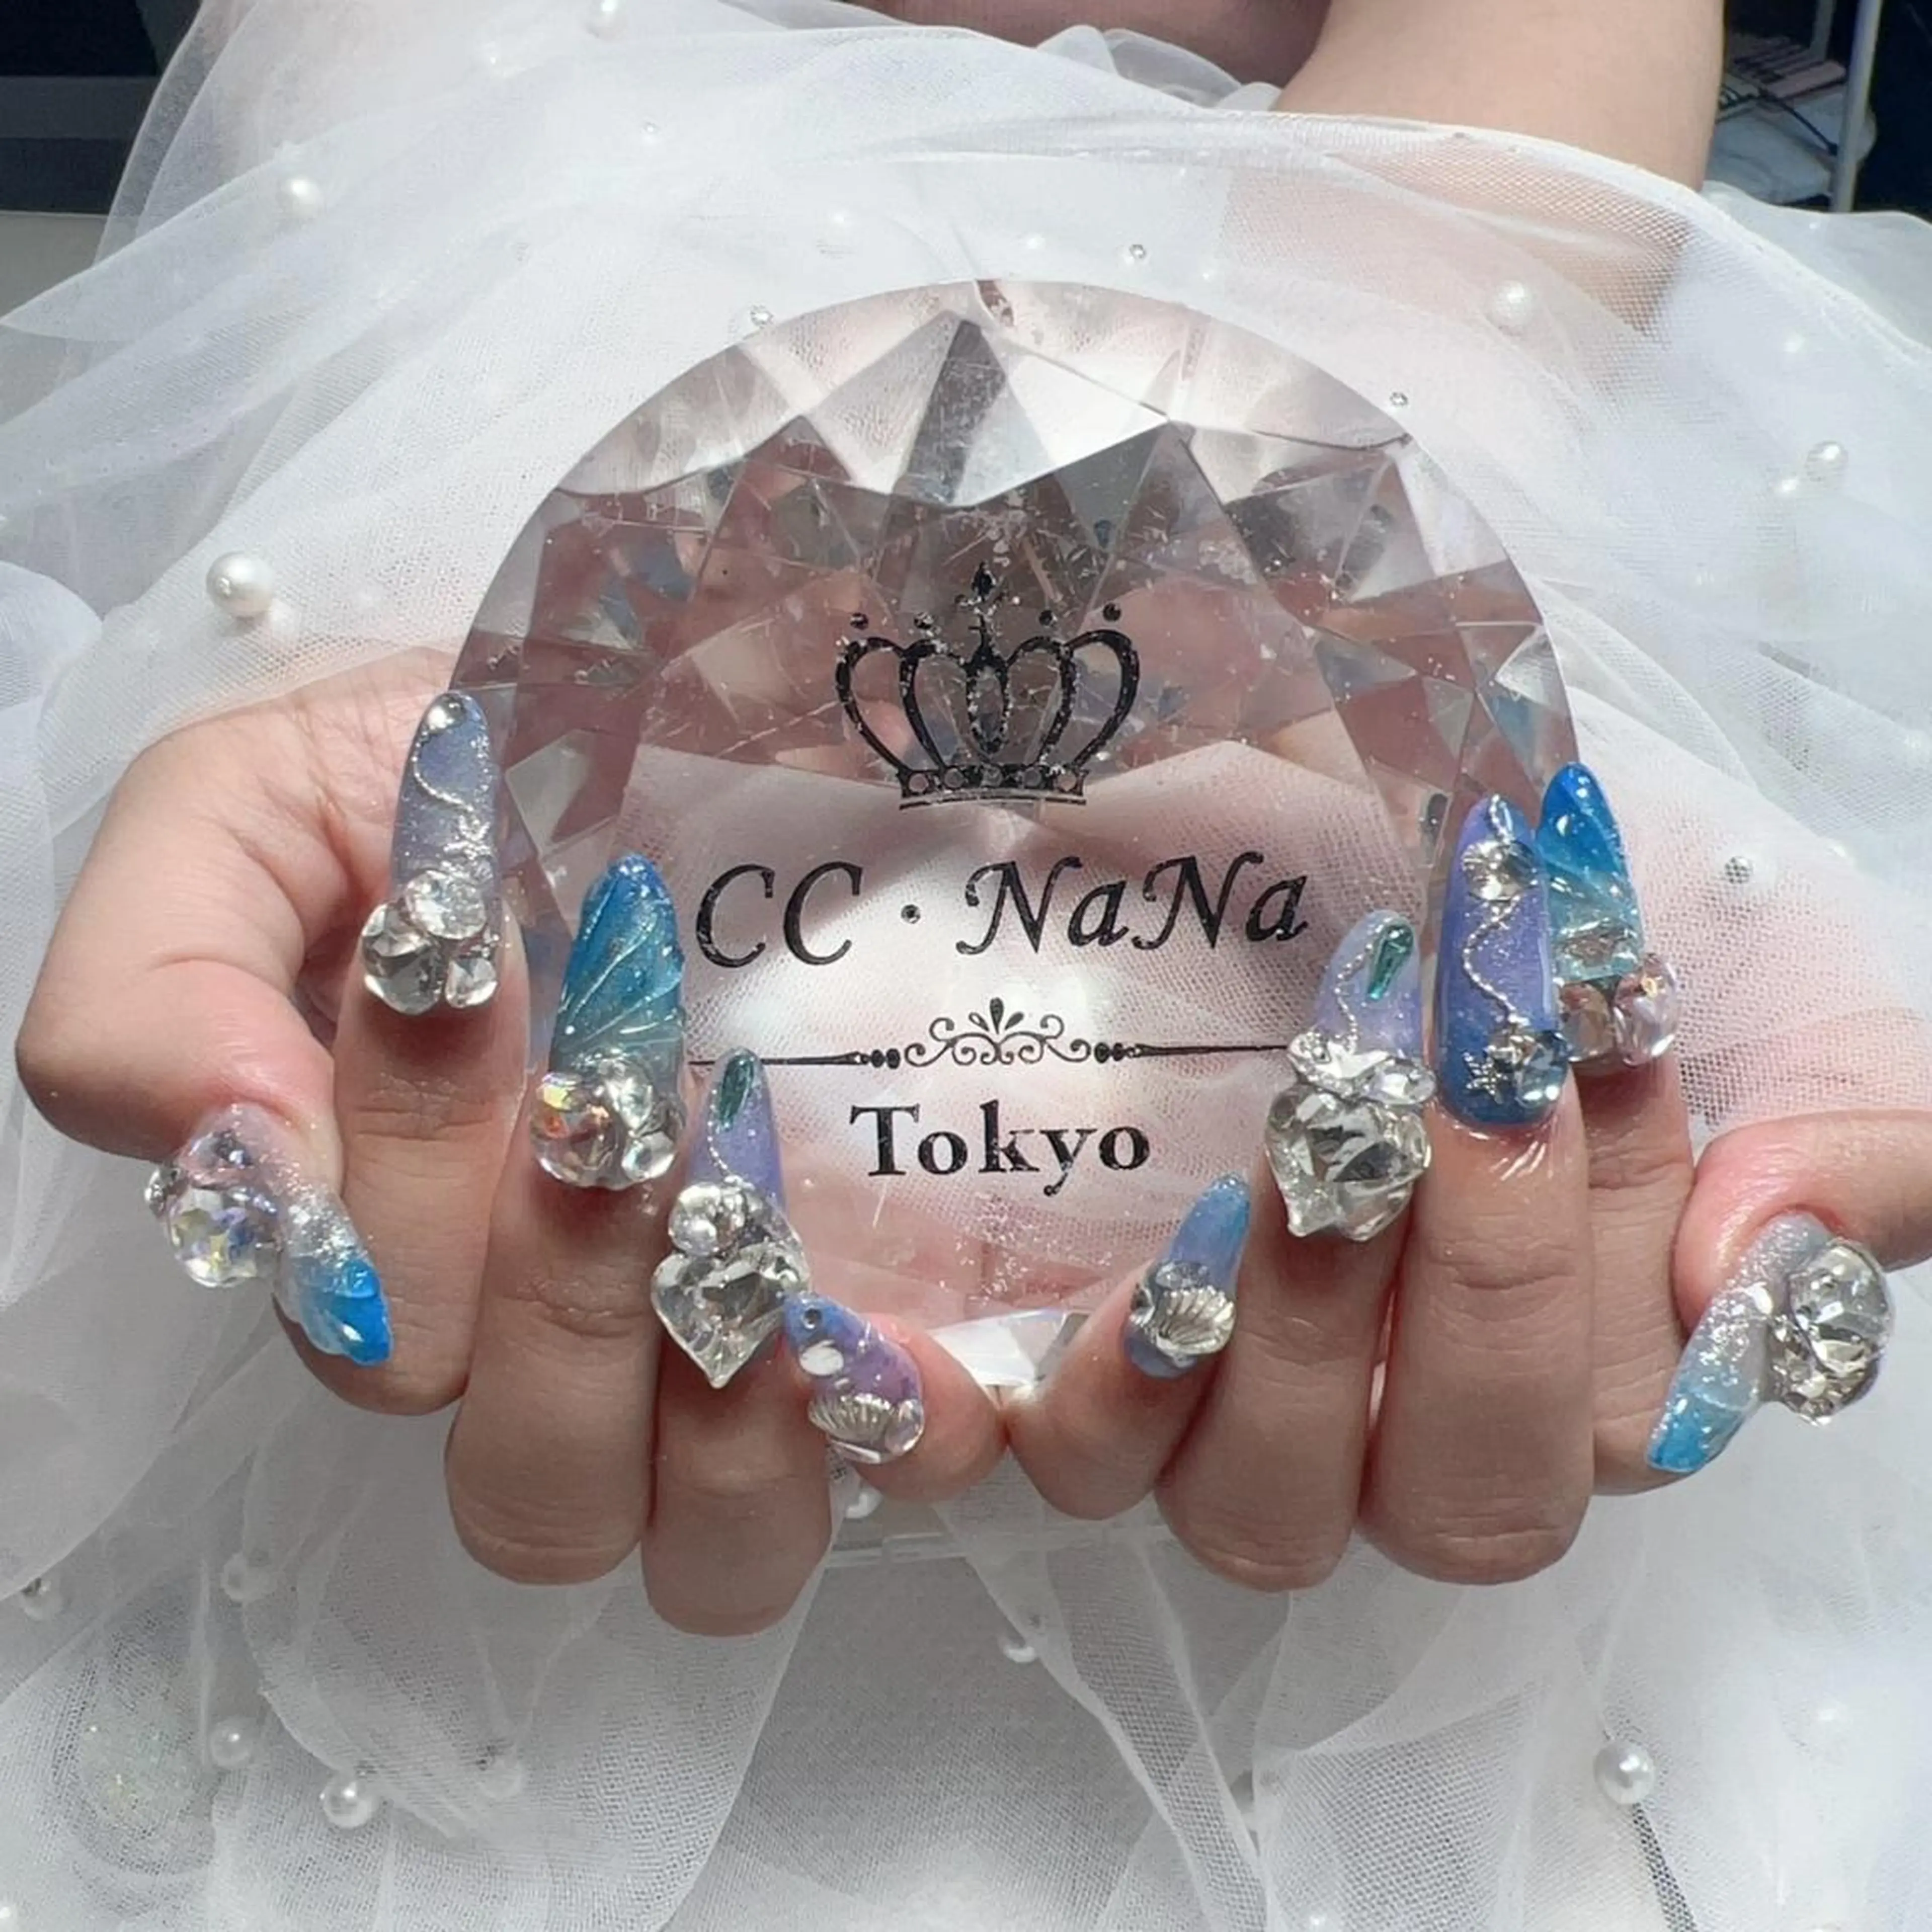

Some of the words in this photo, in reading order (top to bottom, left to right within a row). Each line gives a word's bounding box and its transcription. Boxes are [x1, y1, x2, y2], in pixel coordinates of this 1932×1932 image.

[696, 861, 863, 968] CC
[955, 851, 1309, 955] NaNa
[850, 1099, 1151, 1196] Tokyo
